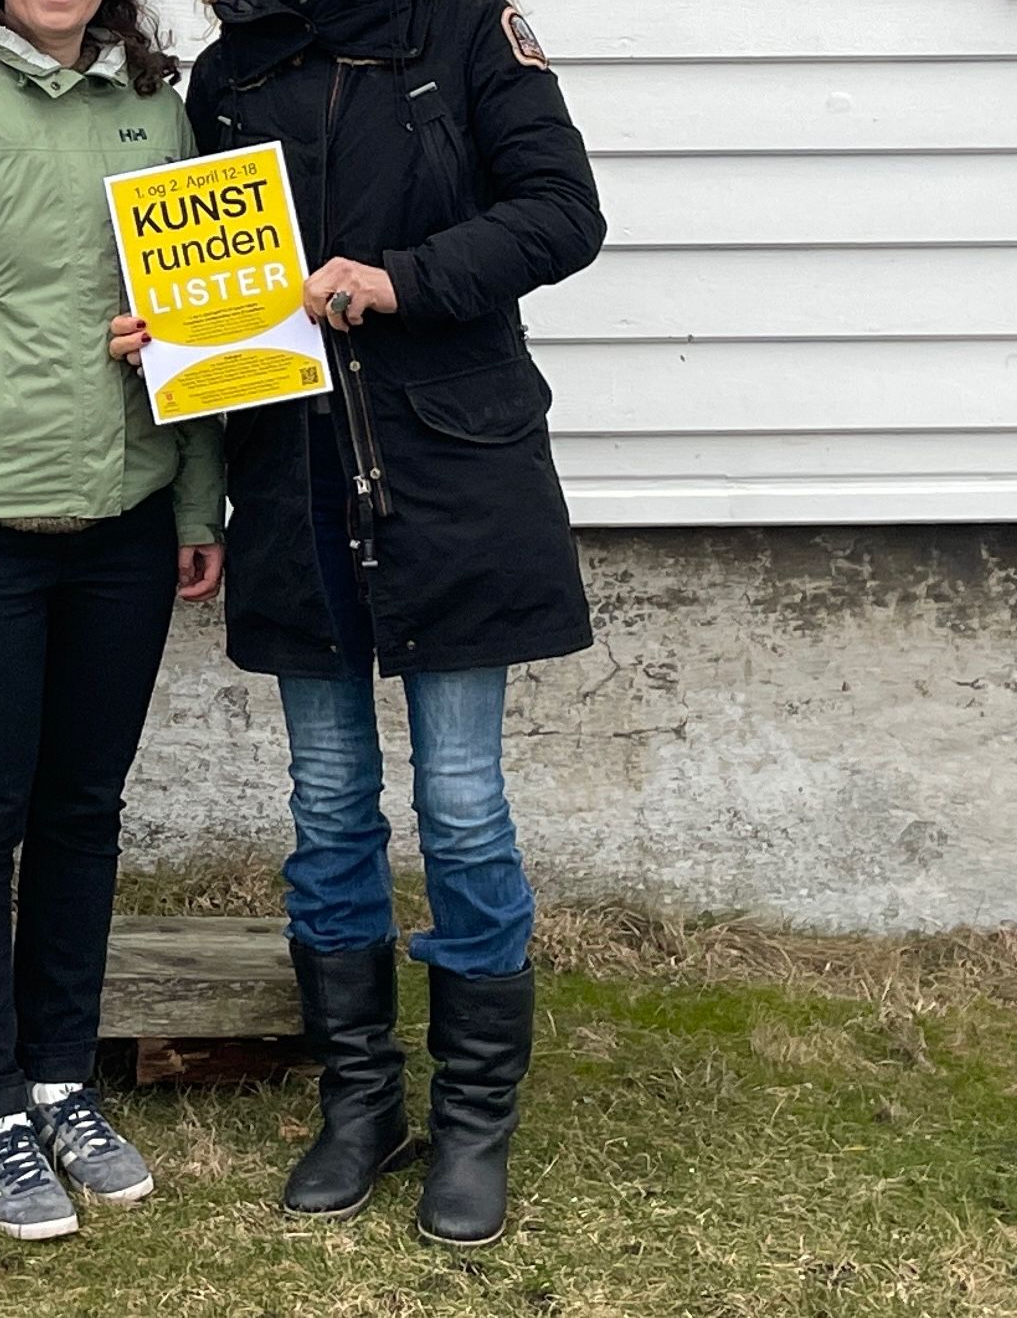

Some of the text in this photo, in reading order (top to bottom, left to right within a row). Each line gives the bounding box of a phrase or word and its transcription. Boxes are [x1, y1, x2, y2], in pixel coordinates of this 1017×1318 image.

[134, 186, 145, 199] 1.
[147, 184, 167, 198] og
[186, 169, 220, 189] April
[222, 162, 258, 181] 12-18
[132, 179, 268, 238] KUNST
[142, 224, 281, 275] runden
[148, 261, 289, 315] LISTER
